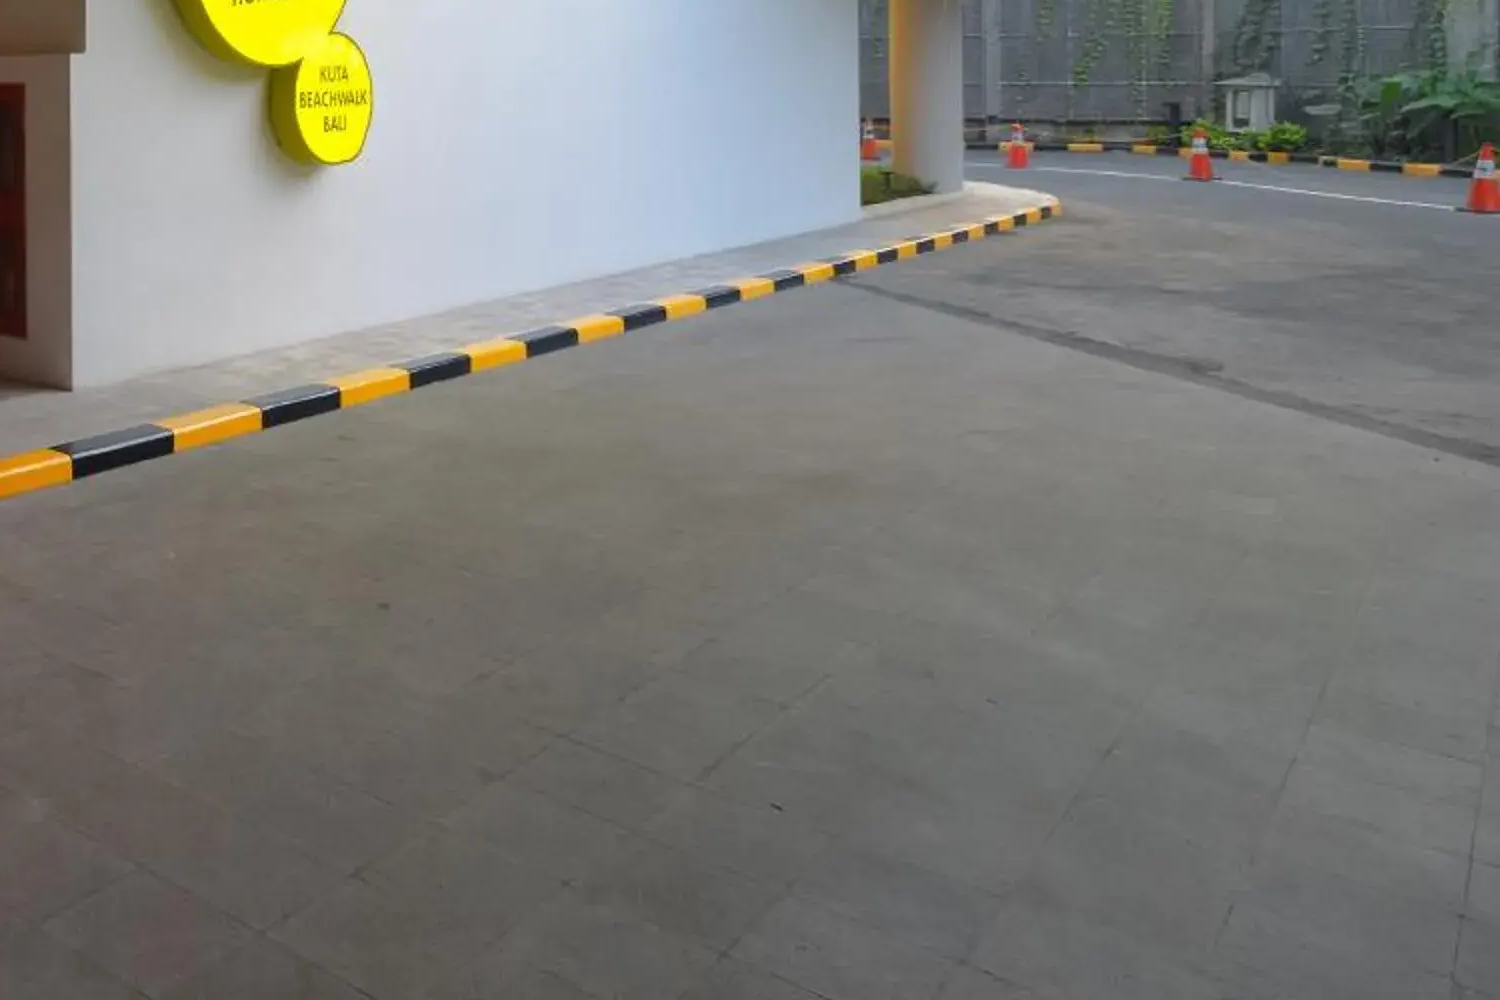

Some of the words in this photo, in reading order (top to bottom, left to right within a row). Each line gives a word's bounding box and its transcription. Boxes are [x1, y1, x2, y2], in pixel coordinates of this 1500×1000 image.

[319, 66, 349, 82] KUTA
[299, 89, 368, 109] BEACHWALK
[323, 115, 347, 133] BALI
